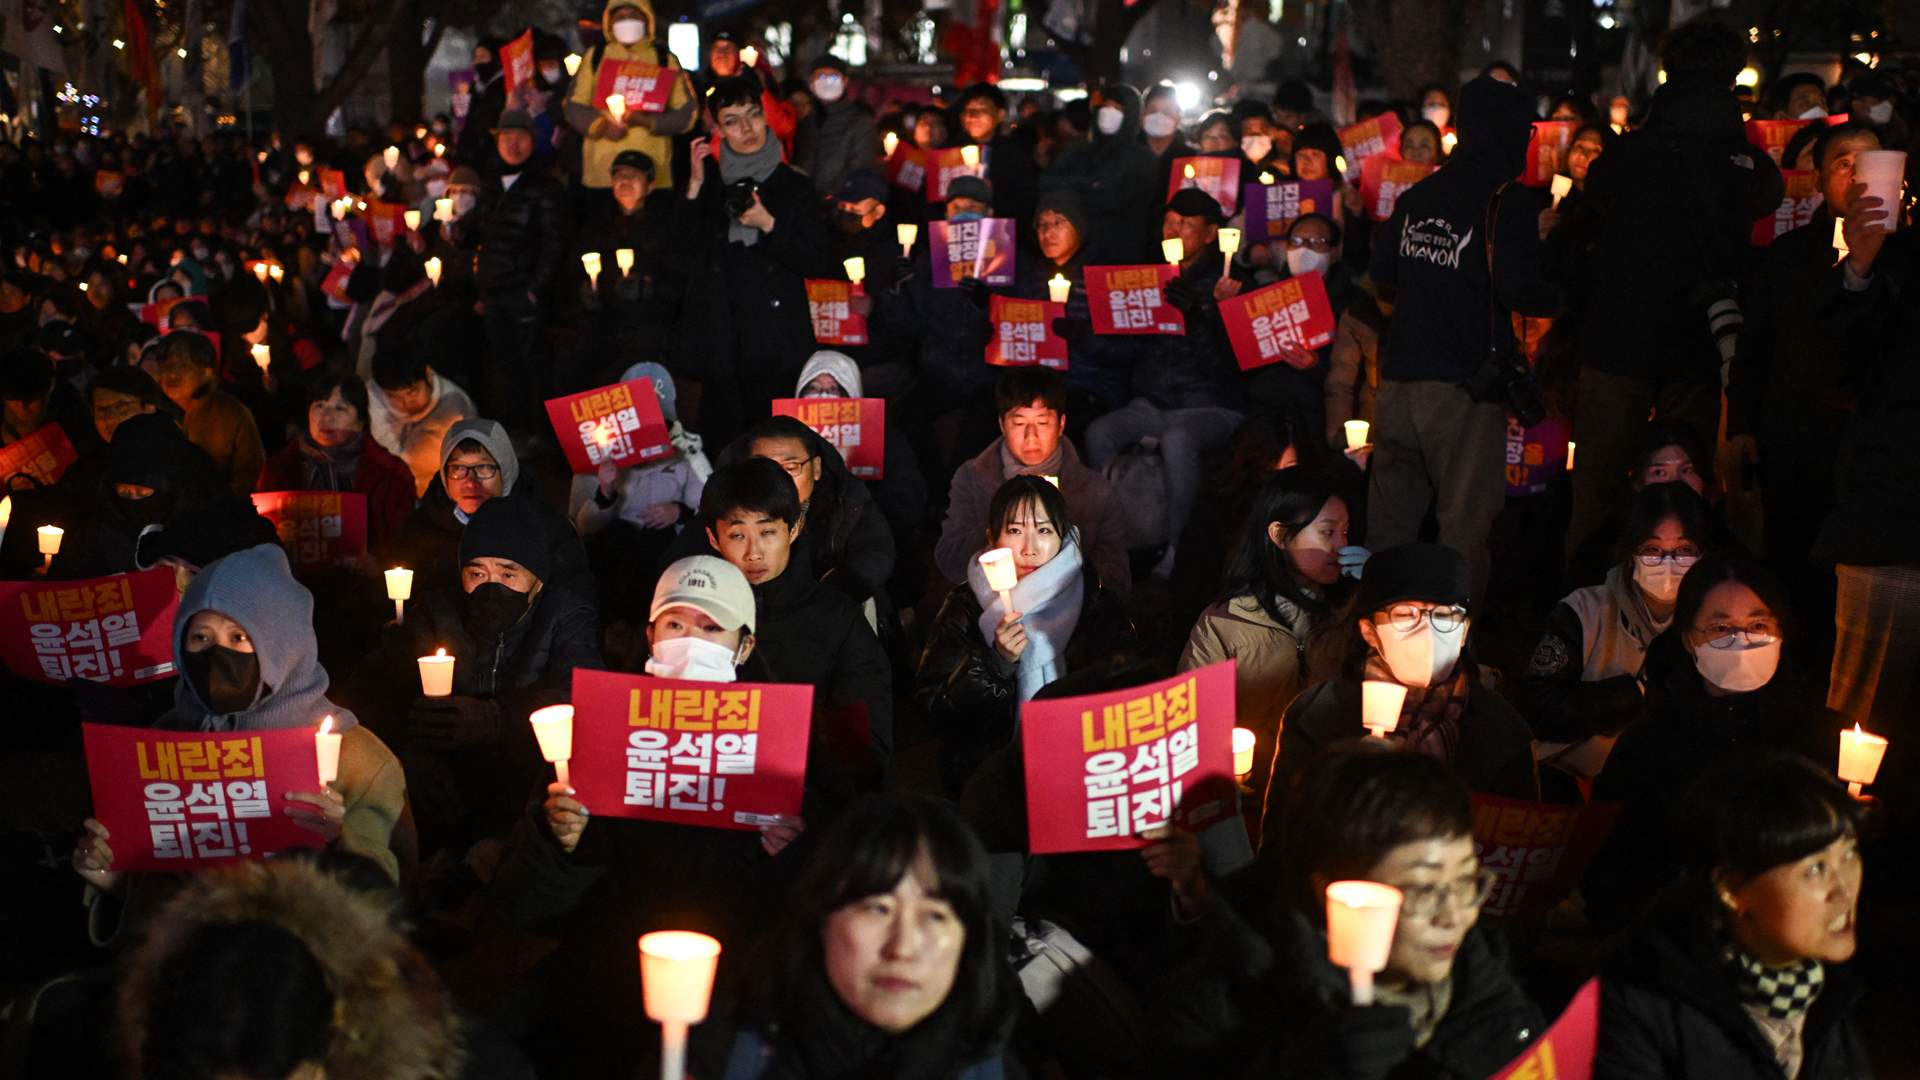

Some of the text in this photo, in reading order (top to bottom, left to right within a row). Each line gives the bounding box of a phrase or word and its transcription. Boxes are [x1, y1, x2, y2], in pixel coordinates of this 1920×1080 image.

[1106, 267, 1159, 291] 내란죄
[1109, 287, 1162, 311] 윤석열
[1243, 278, 1304, 319] 내란죄
[1000, 320, 1046, 342] 윤석열
[1112, 308, 1155, 329] 퇴진!
[1252, 299, 1311, 340] 윤석열
[569, 384, 634, 423] 내란죄
[798, 401, 861, 426] 내란죄
[577, 406, 641, 446] 윤석열
[808, 423, 861, 448] 석열
[19, 578, 135, 622] 내란죄
[30, 610, 141, 655] 윤석열
[37, 649, 125, 684] 퇴진!
[628, 688, 762, 731] 내란죄
[1081, 677, 1198, 753] 내란죄
[135, 736, 265, 781] 내란죄
[625, 730, 759, 775] 윤석열
[1084, 722, 1200, 800] 윤석열
[143, 780, 272, 822] 윤석열
[623, 770, 727, 813] 퇴진!
[150, 820, 252, 860] 퇴진!
[1476, 842, 1571, 883] 석열
